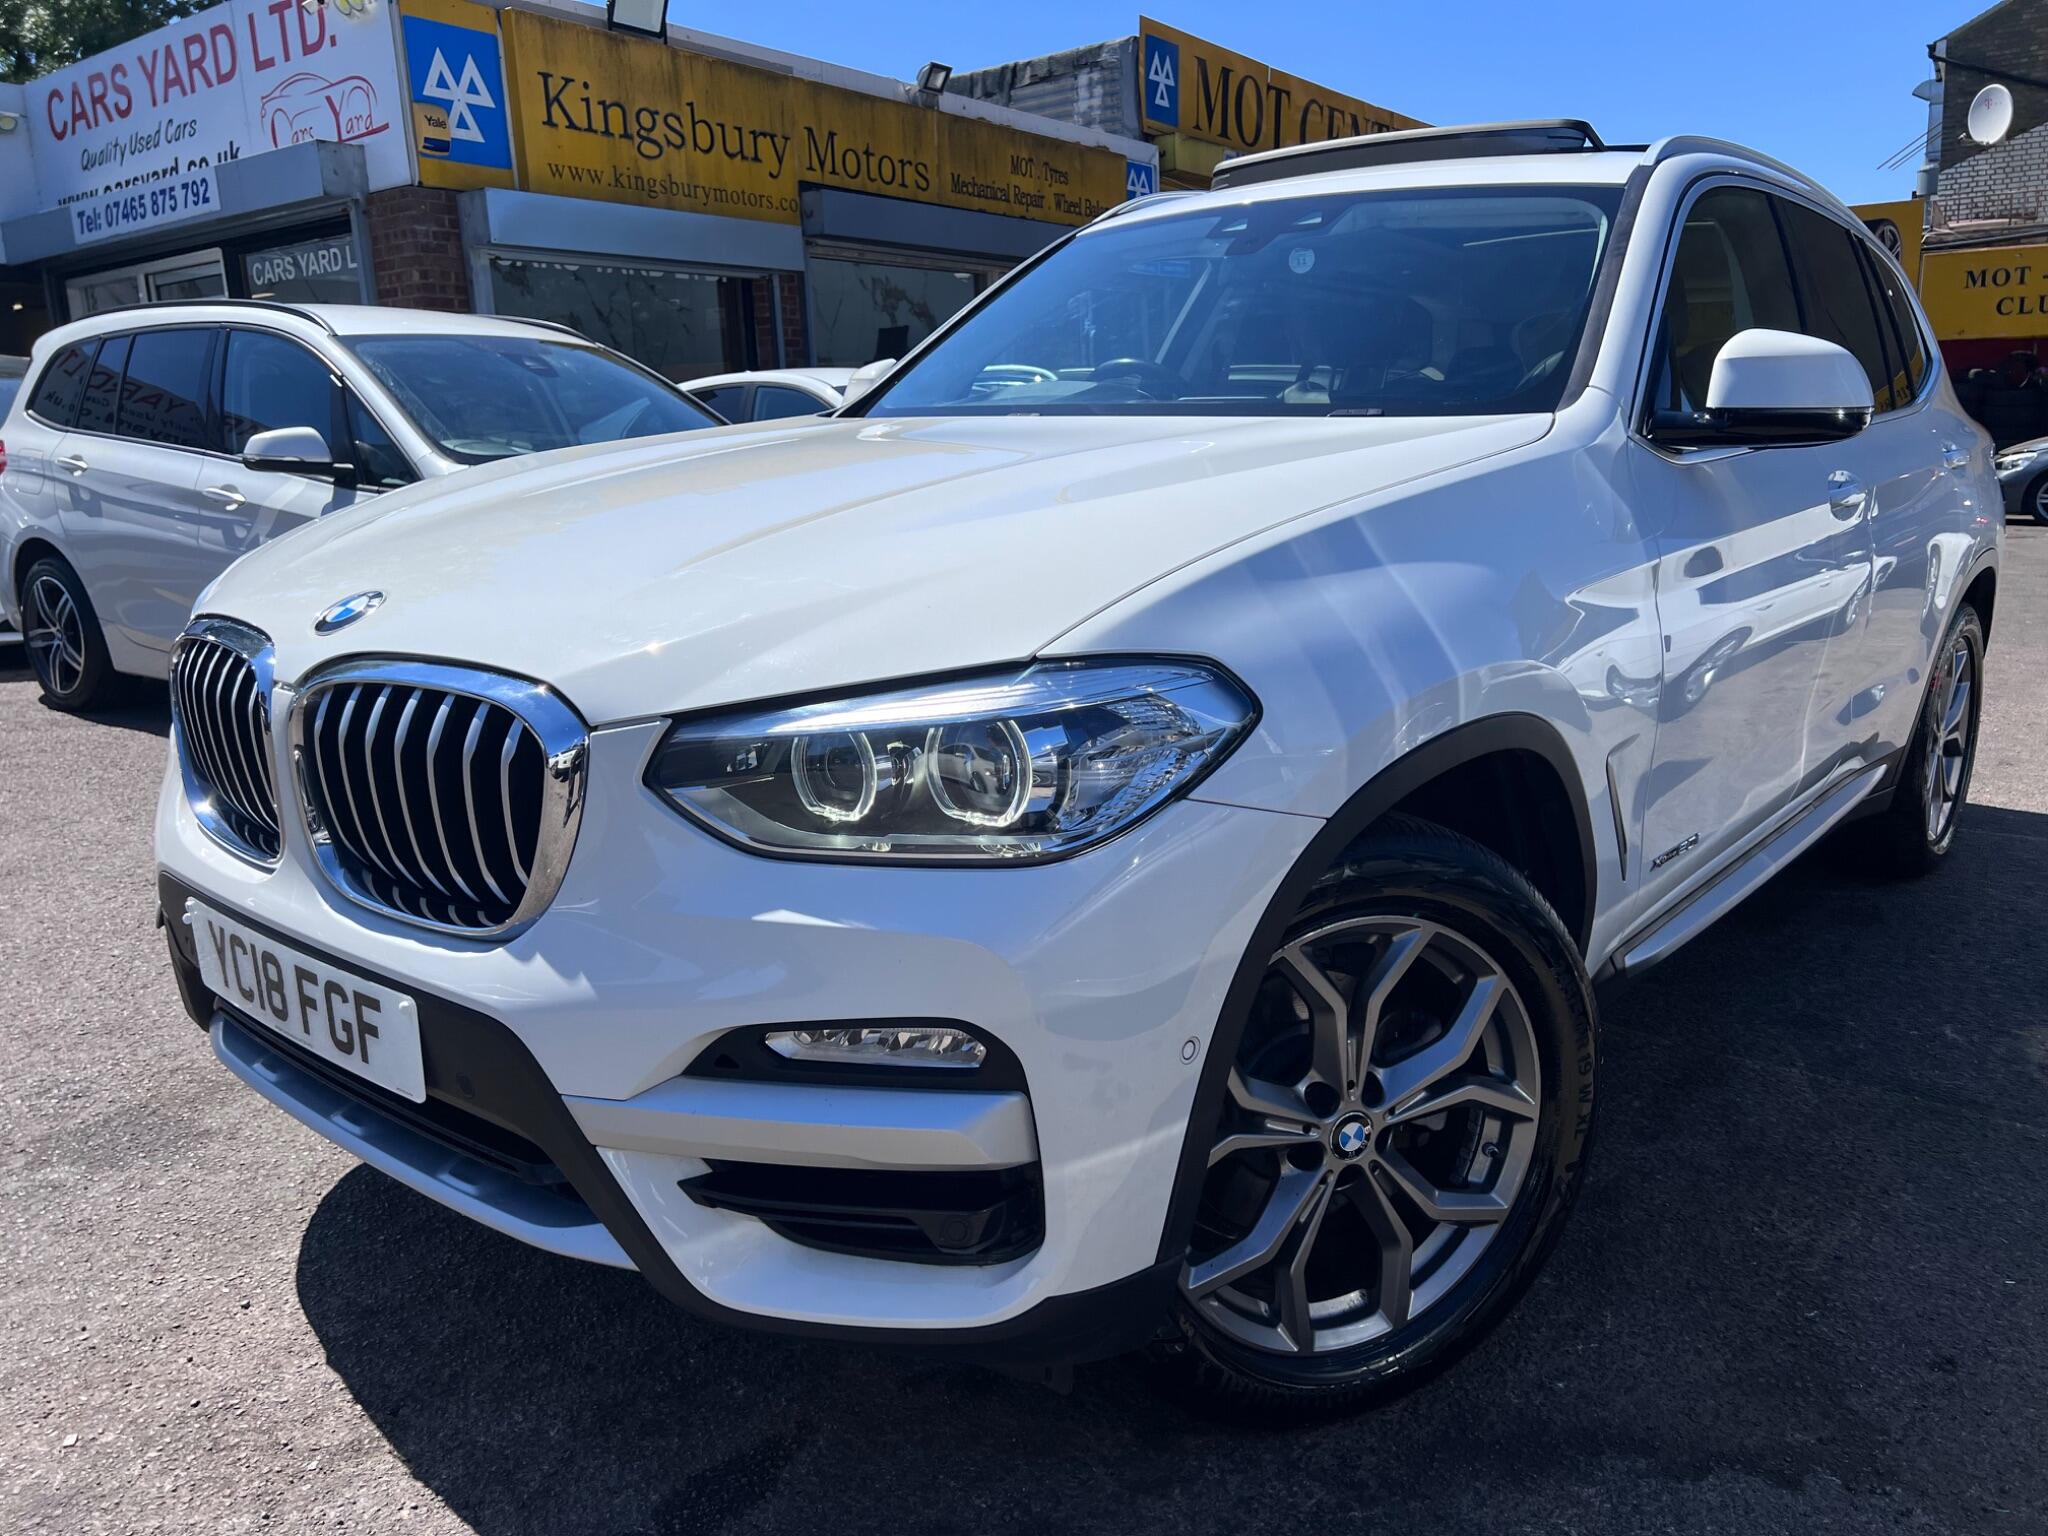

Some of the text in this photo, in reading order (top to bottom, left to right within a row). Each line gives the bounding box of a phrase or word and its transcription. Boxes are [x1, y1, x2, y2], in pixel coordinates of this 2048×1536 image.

[47, 0, 336, 141] CARS YARD LTD.
[424, 114, 447, 130] Yale
[1192, 56, 1291, 150] MOT
[81, 118, 197, 171] Quality Used Cars
[537, 71, 930, 193] Kingsbury Motors
[548, 161, 799, 213] www.kingsburymotors.co
[951, 172, 1009, 201] Mechanical
[1013, 184, 1045, 212] Repair
[1054, 193, 1082, 216] Wheel
[1010, 155, 1069, 187] MOT Tyres
[77, 177, 211, 235] Tel: 07465 875 792
[252, 256, 296, 285] CARS
[300, 248, 343, 276] YARD
[1964, 265, 2032, 289] MOT
[208, 920, 382, 1064] YC18 FGF
